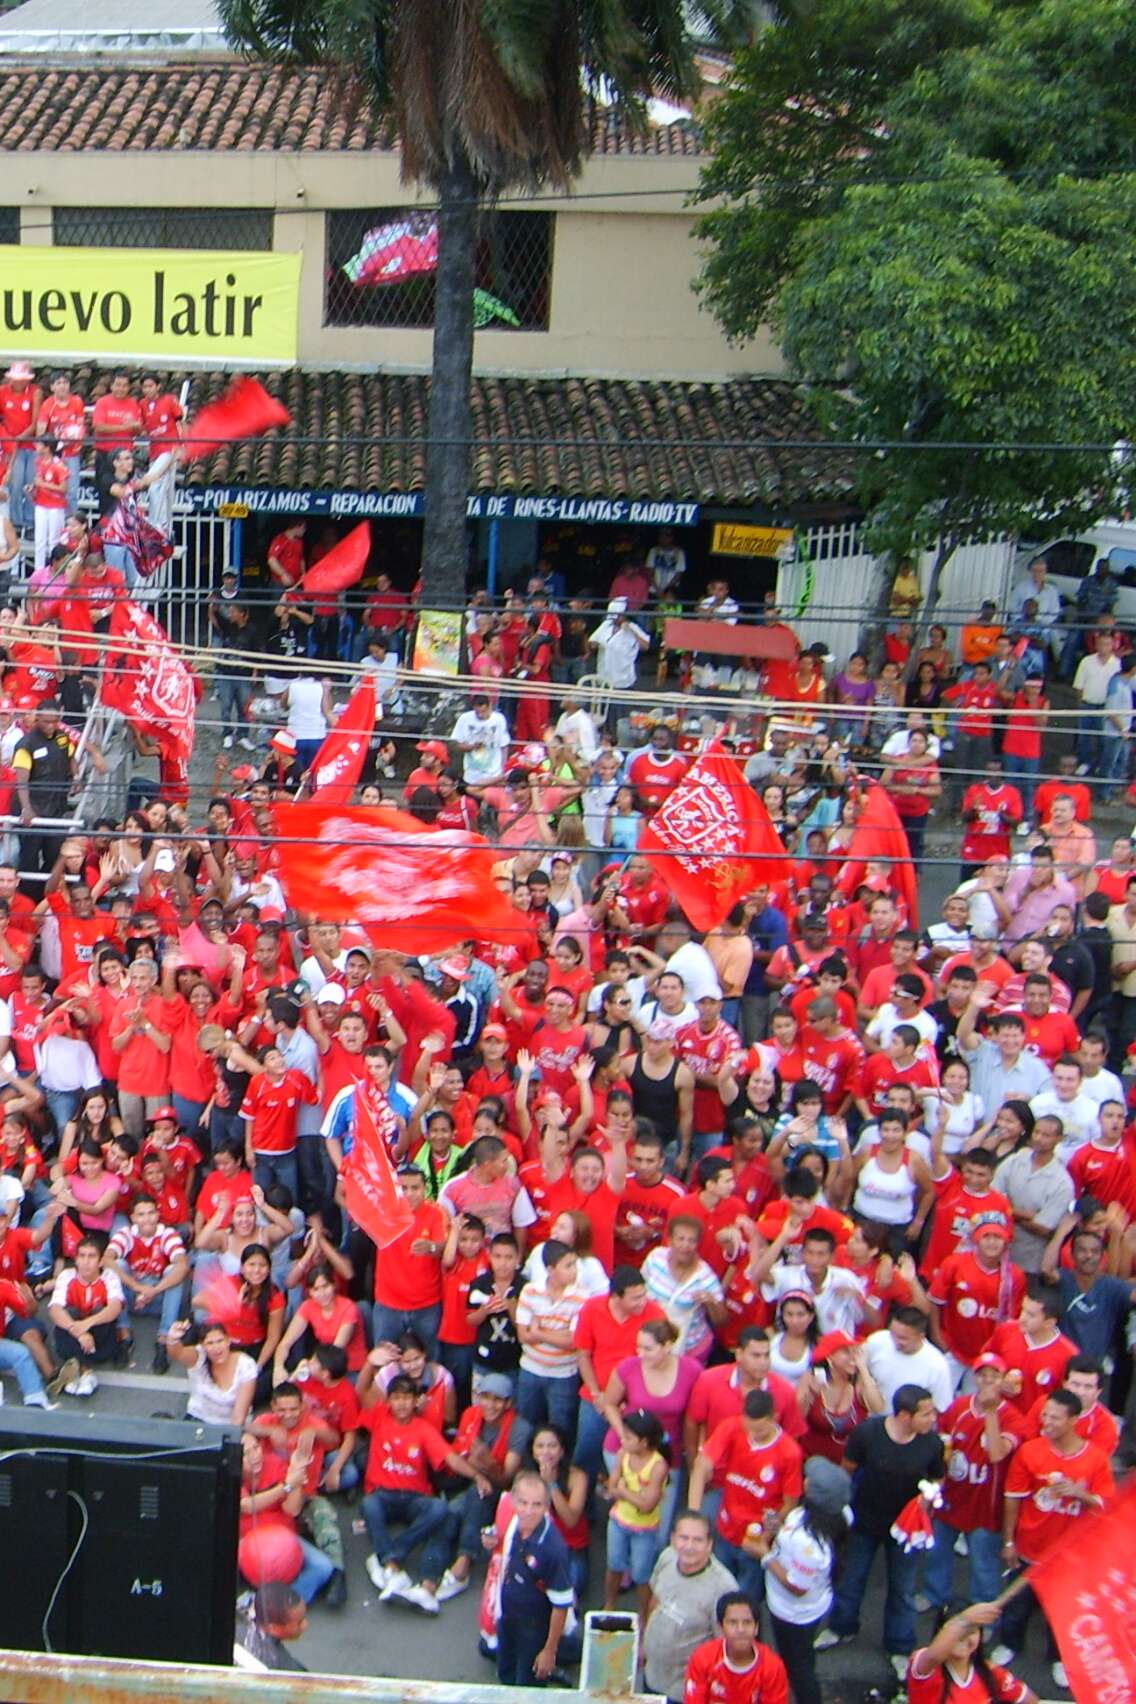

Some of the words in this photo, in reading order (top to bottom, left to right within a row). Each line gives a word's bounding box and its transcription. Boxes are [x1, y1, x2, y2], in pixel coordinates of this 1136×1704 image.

[154, 271, 264, 338] latir
[330, 493, 417, 514] REPARACION
[486, 496, 508, 516] DE
